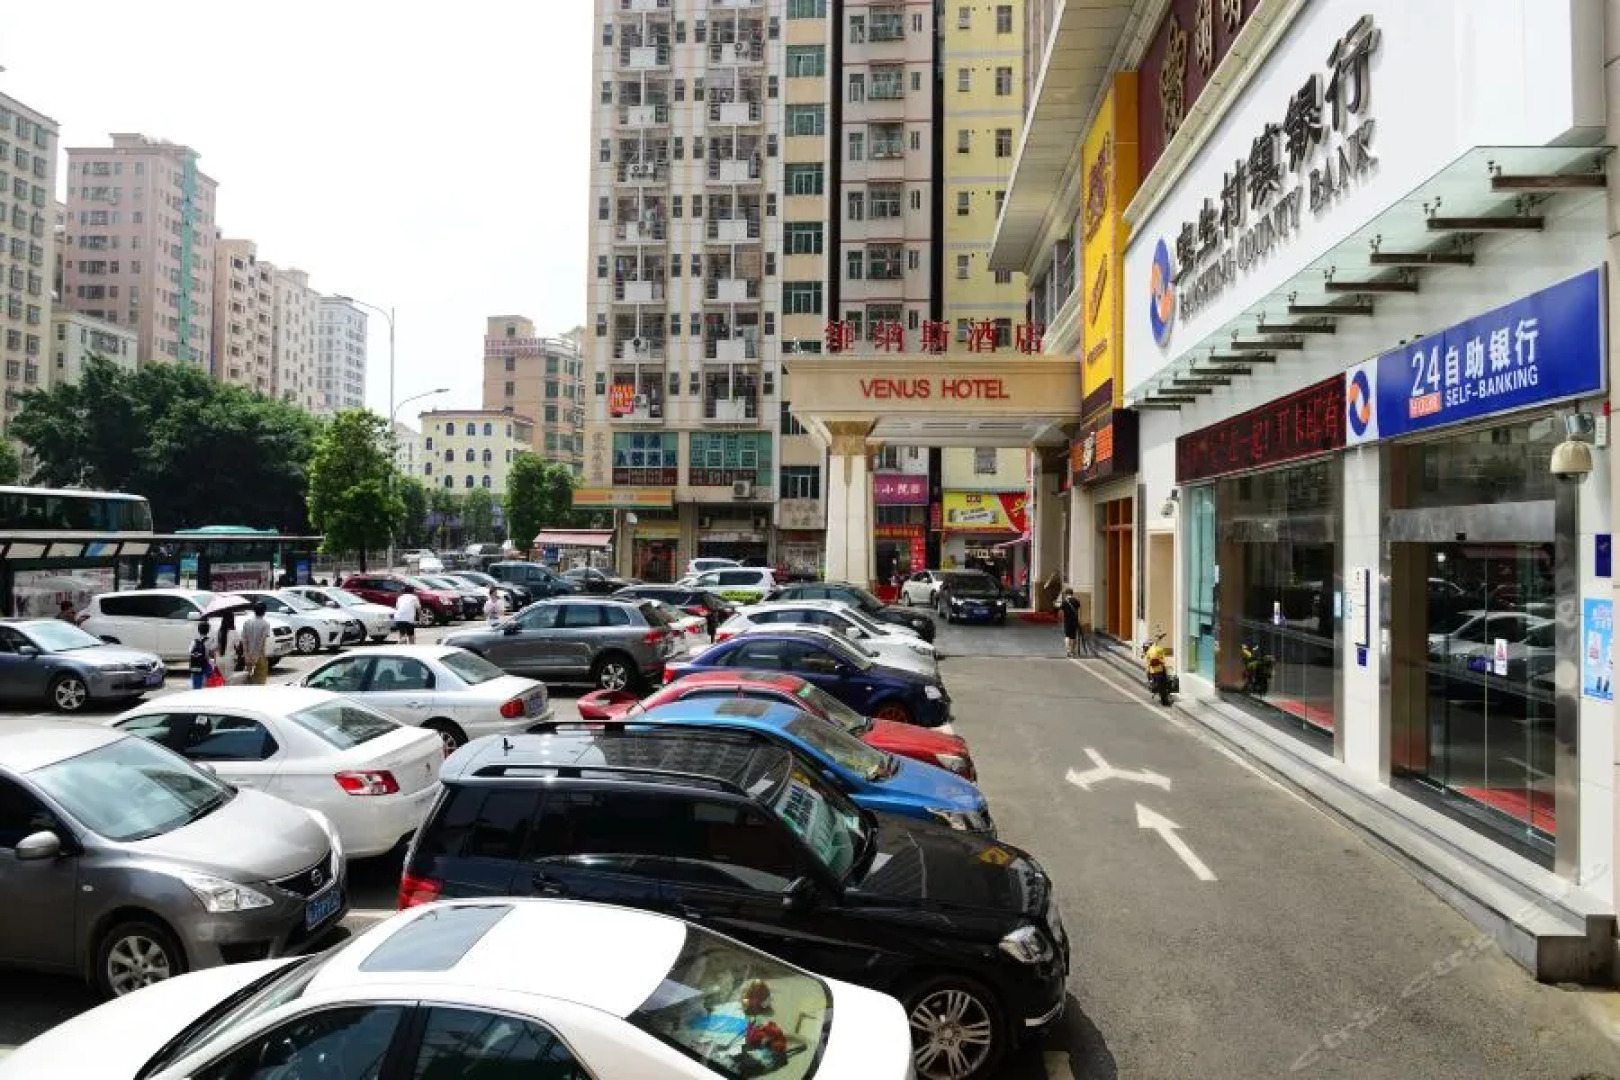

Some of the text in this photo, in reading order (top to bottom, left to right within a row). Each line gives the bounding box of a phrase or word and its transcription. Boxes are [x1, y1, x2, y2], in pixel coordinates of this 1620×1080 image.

[1309, 118, 1380, 217] BANK
[1411, 318, 1539, 397] 24 自助银行
[1445, 364, 1538, 407] SELF-BANKING
[860, 378, 1011, 399] VENUS HOTEL
